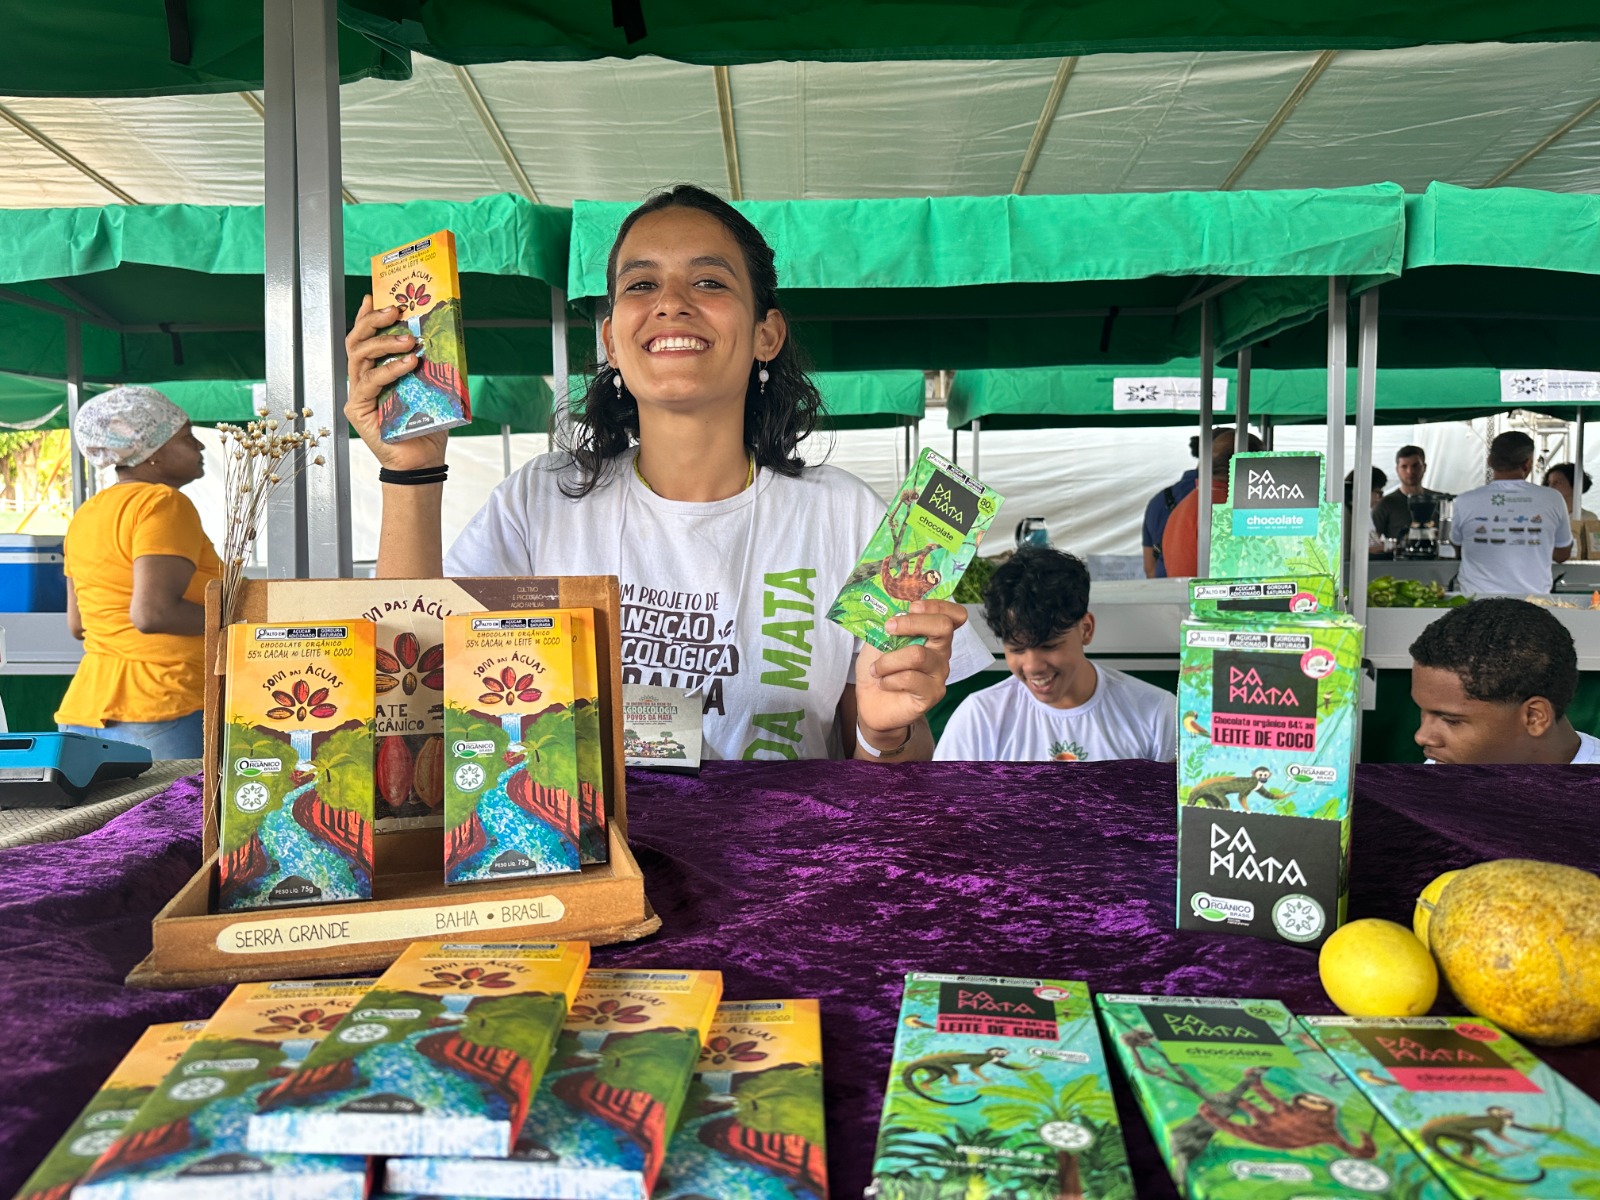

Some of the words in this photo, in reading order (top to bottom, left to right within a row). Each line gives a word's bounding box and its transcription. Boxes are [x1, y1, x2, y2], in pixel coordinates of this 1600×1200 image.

[1248, 469, 1275, 484] DA
[934, 483, 951, 502] DA
[1248, 483, 1305, 500] MATA
[928, 494, 963, 524] MATA
[919, 515, 954, 541] chocolate
[1246, 515, 1304, 525] chocolate
[384, 600, 408, 612] DAS
[639, 586, 702, 610] PROJETO
[706, 592, 720, 611] DE
[518, 629, 550, 637] ORGÂNICO
[760, 568, 817, 691] MATA
[306, 639, 342, 647] ORGÂNICO
[480, 639, 503, 648] CACAU
[514, 638, 532, 646] LEITE
[543, 637, 560, 645] COCO
[248, 650, 261, 658] 55%
[264, 650, 288, 658] CACAU
[301, 648, 321, 657] LEITE
[333, 648, 353, 657] COCO
[622, 638, 732, 673] COLÓGICA
[473, 658, 494, 677] SOM
[511, 651, 546, 674] ÁGUAS
[262, 670, 287, 691] SOM
[305, 663, 344, 688] ÁGUAS
[1230, 666, 1263, 686] DA
[1230, 685, 1299, 706] MATA
[376, 704, 408, 718] ATE
[1214, 716, 1250, 726] Chocolate
[1253, 719, 1286, 729] orgânico
[1214, 728, 1250, 745] LEITE
[1255, 730, 1272, 746] DE
[1276, 732, 1313, 748] COCO
[1210, 822, 1256, 854] DA
[517, 859, 529, 867] 75g
[1210, 850, 1307, 887] MATA
[301, 885, 314, 894] 75g
[1198, 897, 1251, 913] ORGÂNICO
[436, 910, 479, 929] BAHIA
[501, 902, 550, 923] BRASIL
[235, 928, 284, 948] SERRA
[289, 921, 350, 942] GRANDE
[958, 990, 994, 1001] DA
[958, 999, 1036, 1014] MATA
[1163, 1013, 1206, 1025] DA
[940, 1022, 983, 1034] LEITE
[987, 1024, 1005, 1034] DE
[1013, 1026, 1057, 1040] COCO
[1170, 1024, 1258, 1038] MATA
[1185, 1047, 1272, 1057] chocolate
